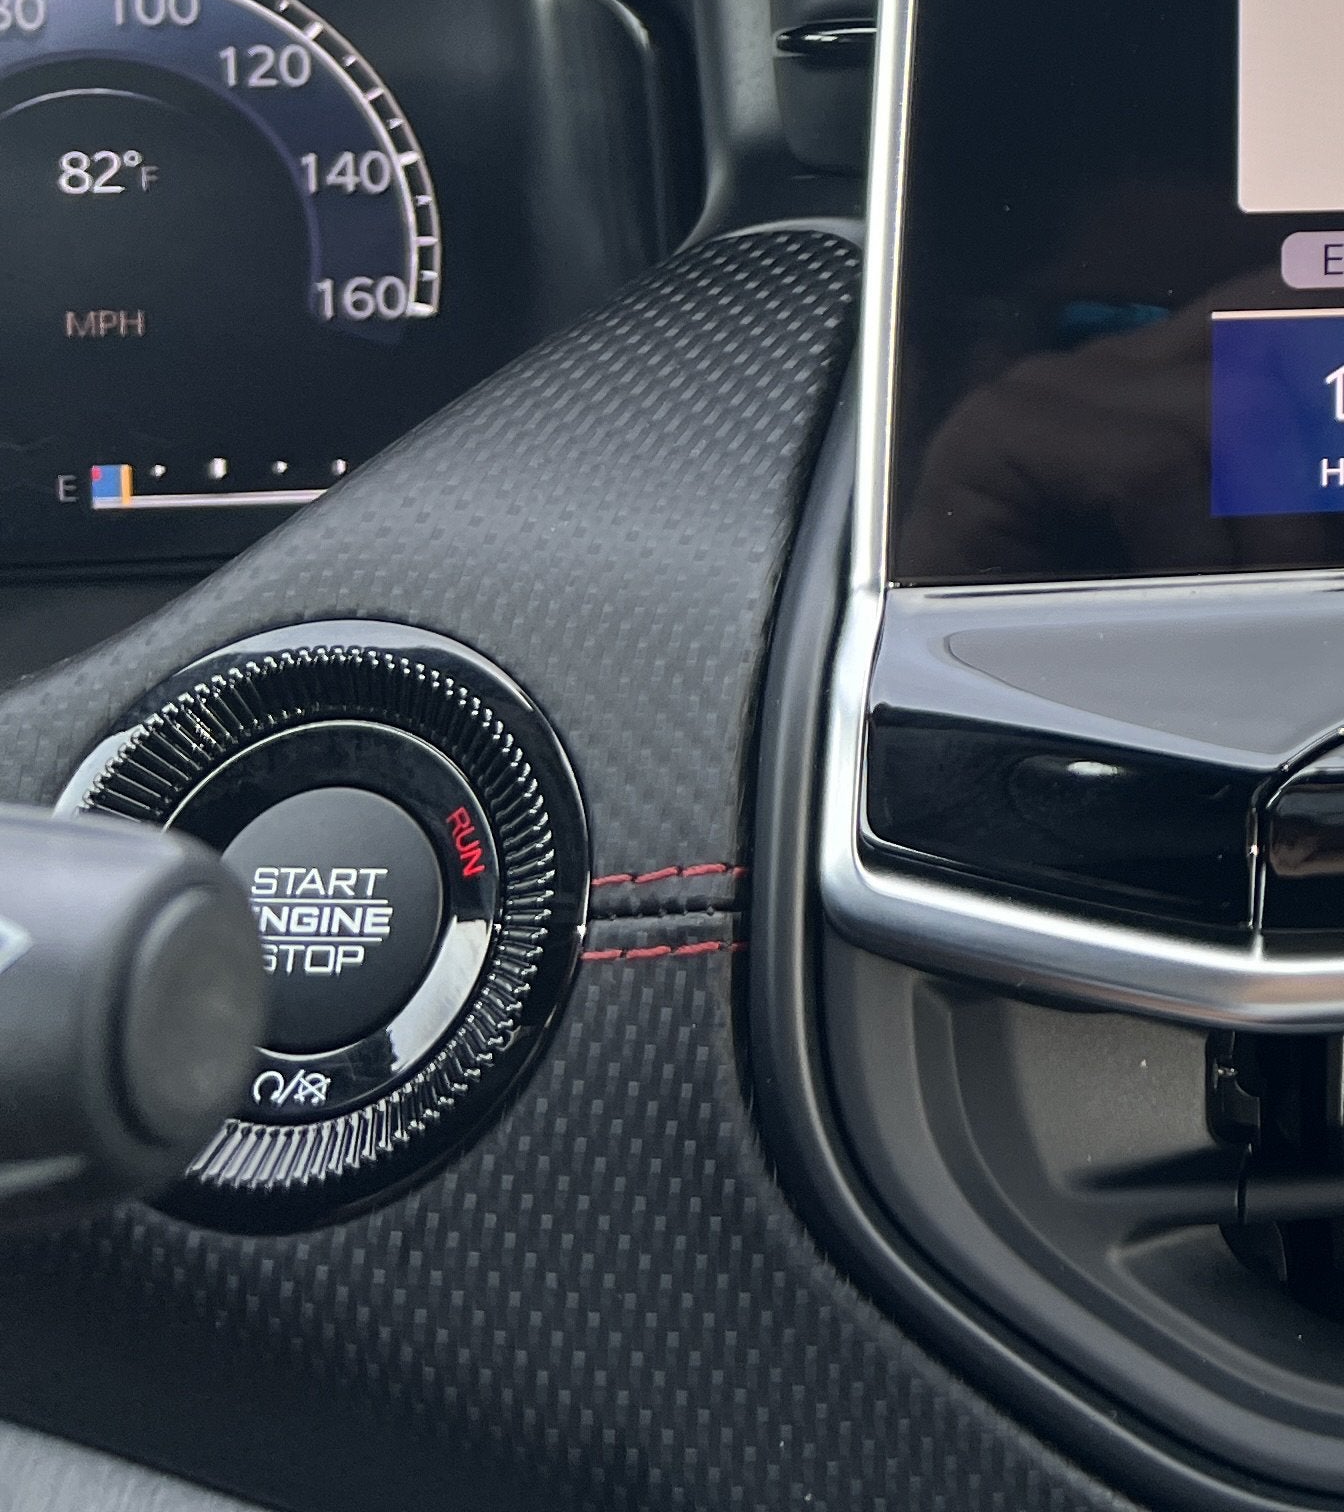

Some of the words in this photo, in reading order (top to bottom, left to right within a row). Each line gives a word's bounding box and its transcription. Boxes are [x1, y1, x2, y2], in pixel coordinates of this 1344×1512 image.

[218, 43, 312, 89] 120
[301, 150, 391, 194] 140
[316, 276, 409, 320] 160
[65, 310, 146, 338] MPH
[58, 475, 76, 502] E
[446, 806, 486, 878] RUN
[251, 867, 388, 896] START
[252, 906, 393, 935] NGINE
